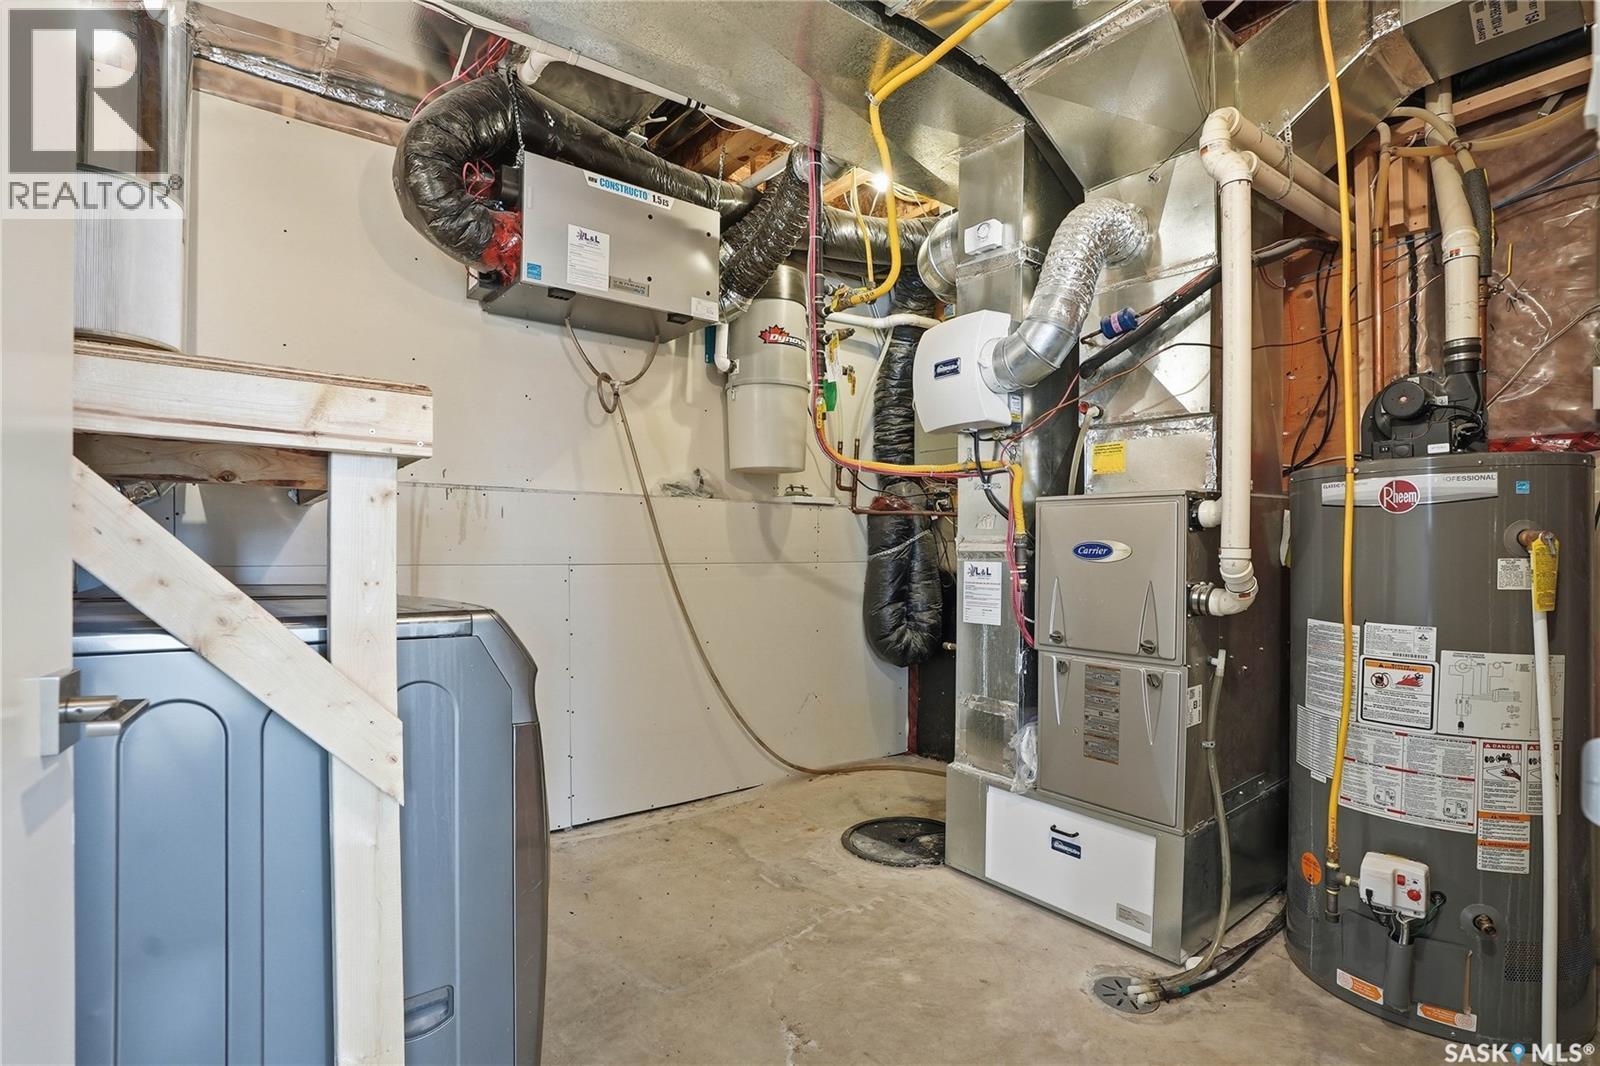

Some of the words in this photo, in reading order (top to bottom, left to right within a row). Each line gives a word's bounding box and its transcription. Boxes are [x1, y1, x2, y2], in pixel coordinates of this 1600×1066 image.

[599, 178, 648, 201] CONSTRUCTO
[1382, 480, 1417, 508] Rheem
[1077, 545, 1109, 556] Carrier
